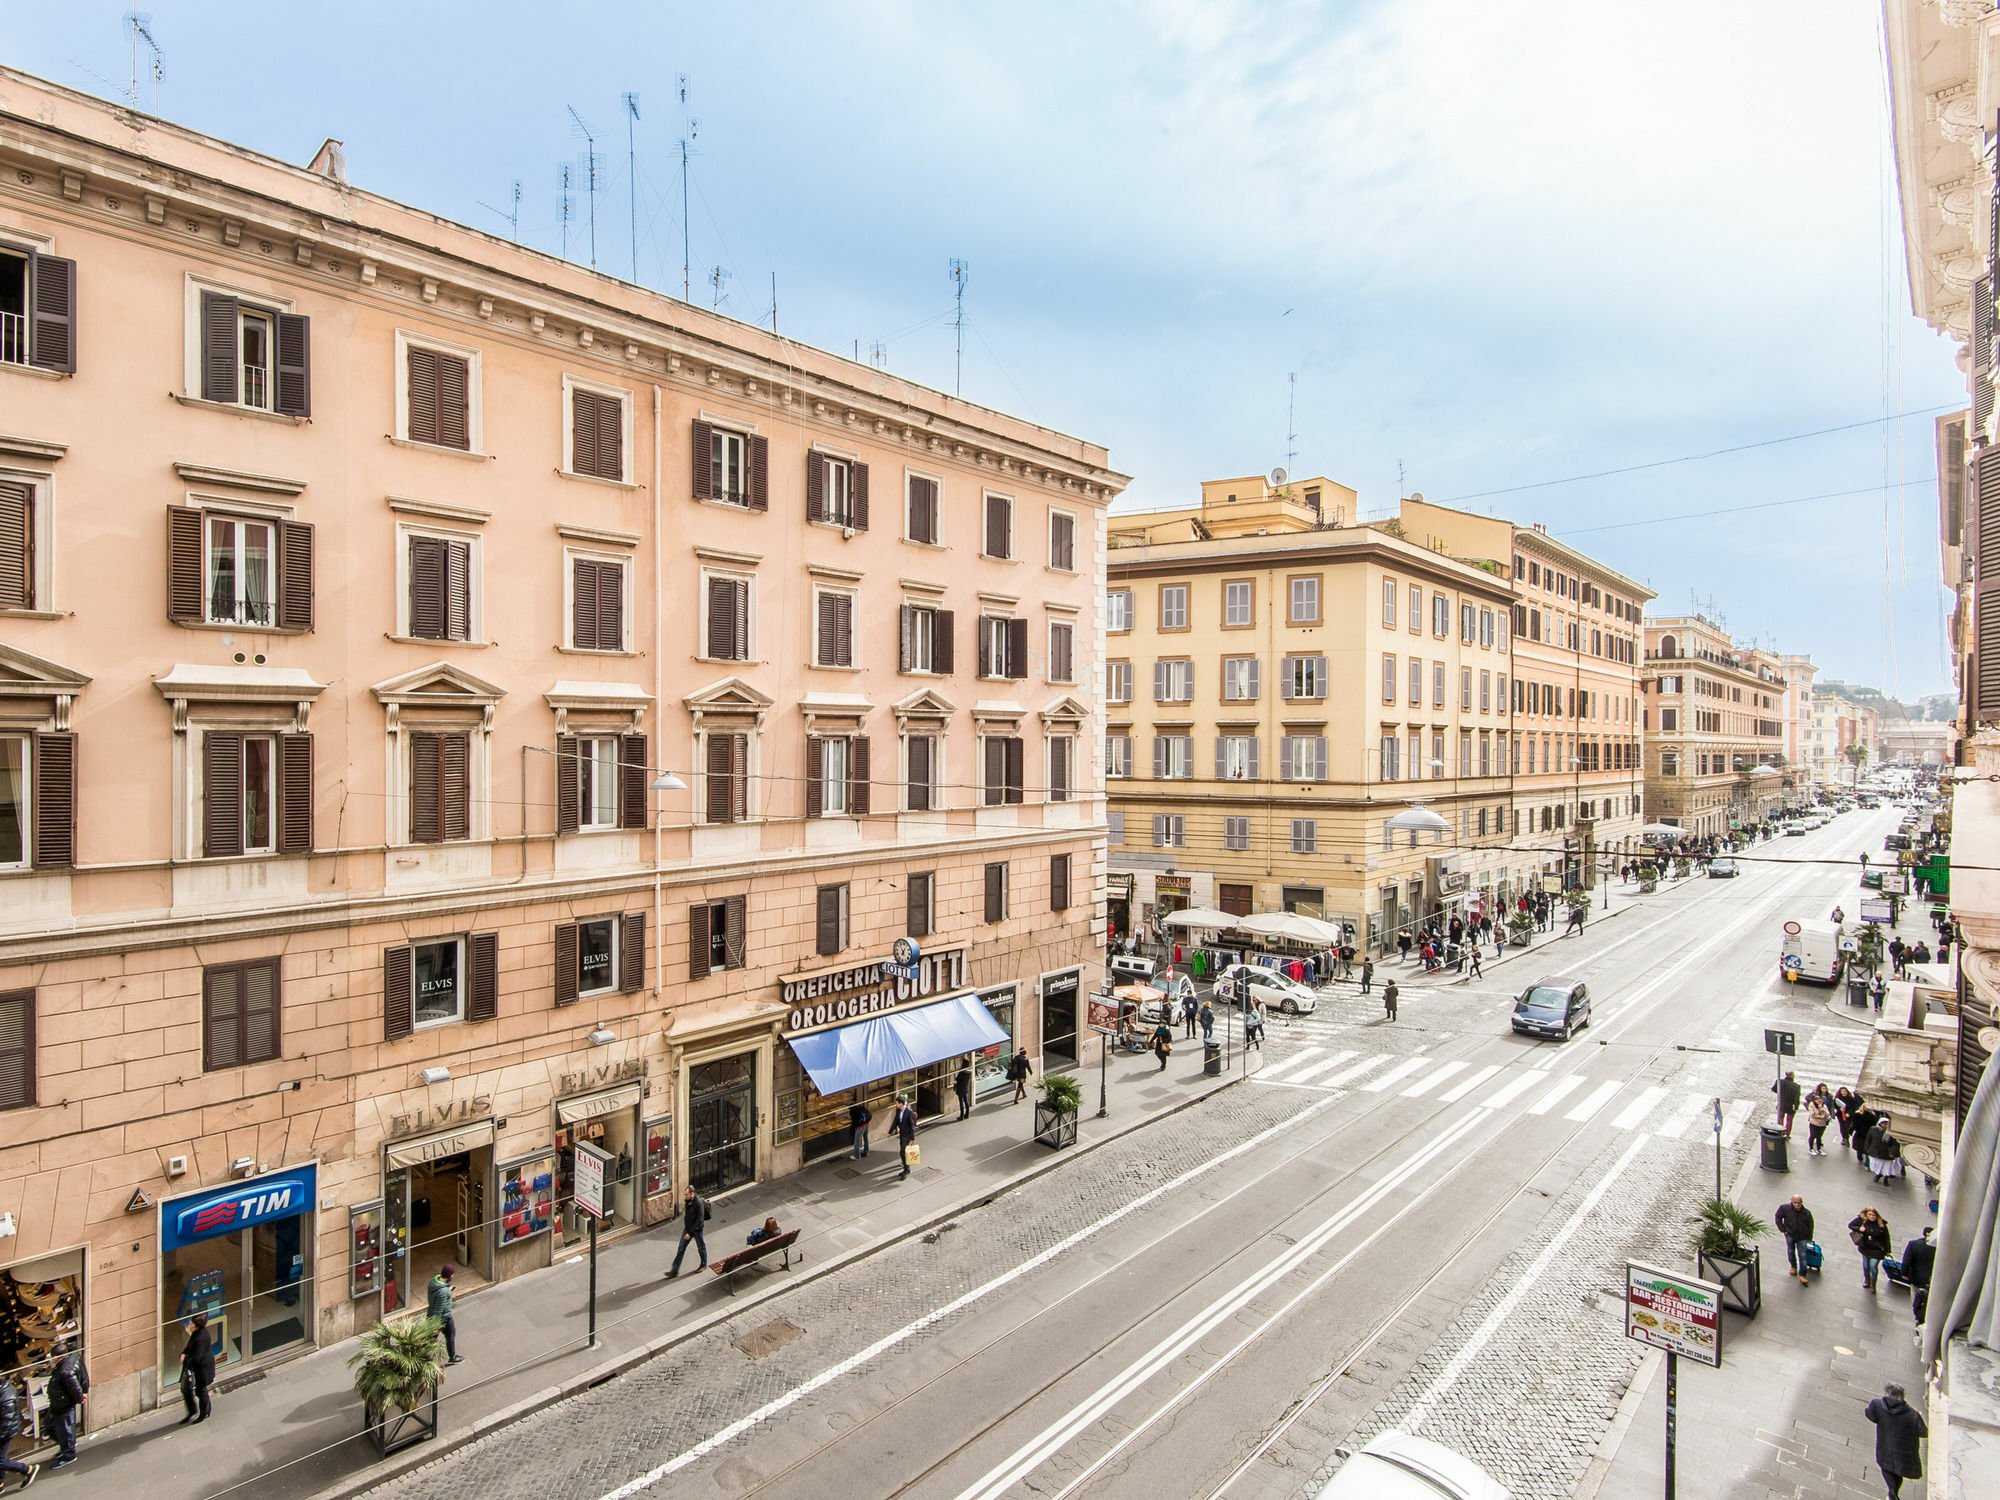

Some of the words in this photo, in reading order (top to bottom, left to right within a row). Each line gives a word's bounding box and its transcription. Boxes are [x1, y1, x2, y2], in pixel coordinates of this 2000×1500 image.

[584, 953, 609, 964] ELVIS
[880, 963, 908, 977] CIOTTI
[421, 978, 453, 991] ELVIS
[784, 965, 881, 1003] OREFICERIA
[791, 988, 896, 1030] OROLOGERIA
[560, 1058, 640, 1092] ELVIS
[391, 1093, 491, 1135] ELVIS
[585, 1096, 620, 1117] ELVIS
[422, 1137, 465, 1161] ELVIS
[577, 1150, 602, 1173] ELVIS
[240, 1188, 291, 1220] TIM
[1633, 1278, 1663, 1293] INDIAN
[1632, 1287, 1654, 1300] BAR
[1655, 1294, 1714, 1320] RESTAURANT
[1652, 1301, 1692, 1322] PIZZERIA
[1680, 1293, 1714, 1308] ITALIAN
